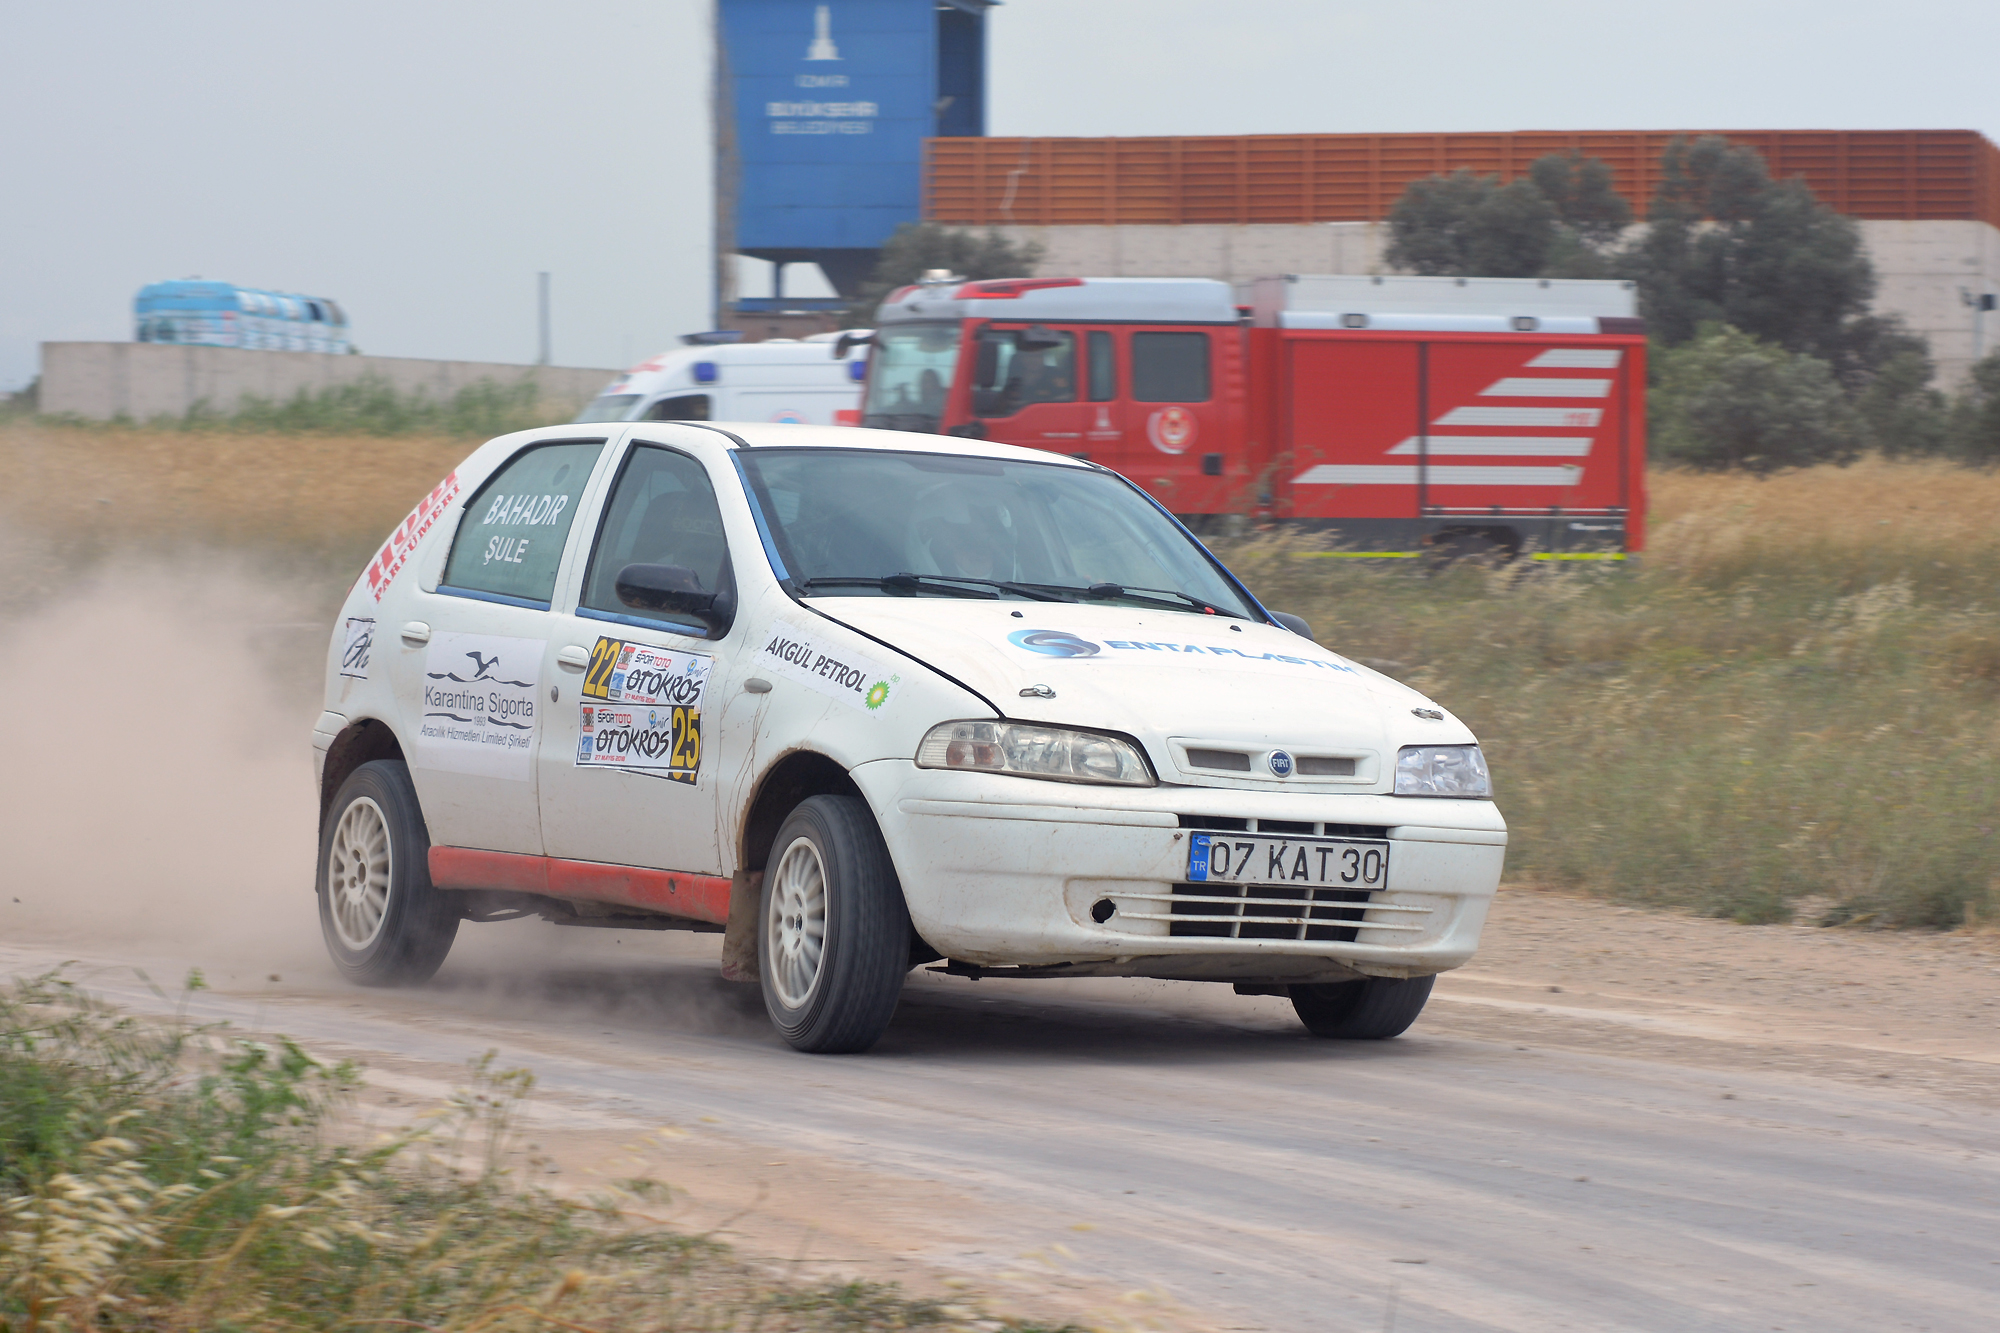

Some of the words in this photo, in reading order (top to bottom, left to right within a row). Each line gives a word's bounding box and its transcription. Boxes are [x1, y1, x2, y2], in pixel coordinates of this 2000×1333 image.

[483, 495, 569, 526] BAHADIR
[483, 535, 529, 566] ŞULE
[583, 639, 621, 698] 22
[765, 636, 813, 669] AKGÜL
[811, 654, 867, 693] PETROL
[626, 668, 704, 704] OTOKROS
[425, 686, 485, 711] Karantina
[488, 692, 534, 719] Sigorta
[447, 727, 481, 743] Hizmetleri
[481, 731, 507, 746] Limited
[474, 716, 487, 727] 1993
[595, 728, 670, 759] OTOKROS
[671, 707, 700, 769] 25
[1272, 758, 1289, 769] FIAT
[1193, 860, 1207, 871] TR
[1210, 841, 1255, 877] 07
[1267, 844, 1334, 882] KAT
[1340, 848, 1382, 884] 30
